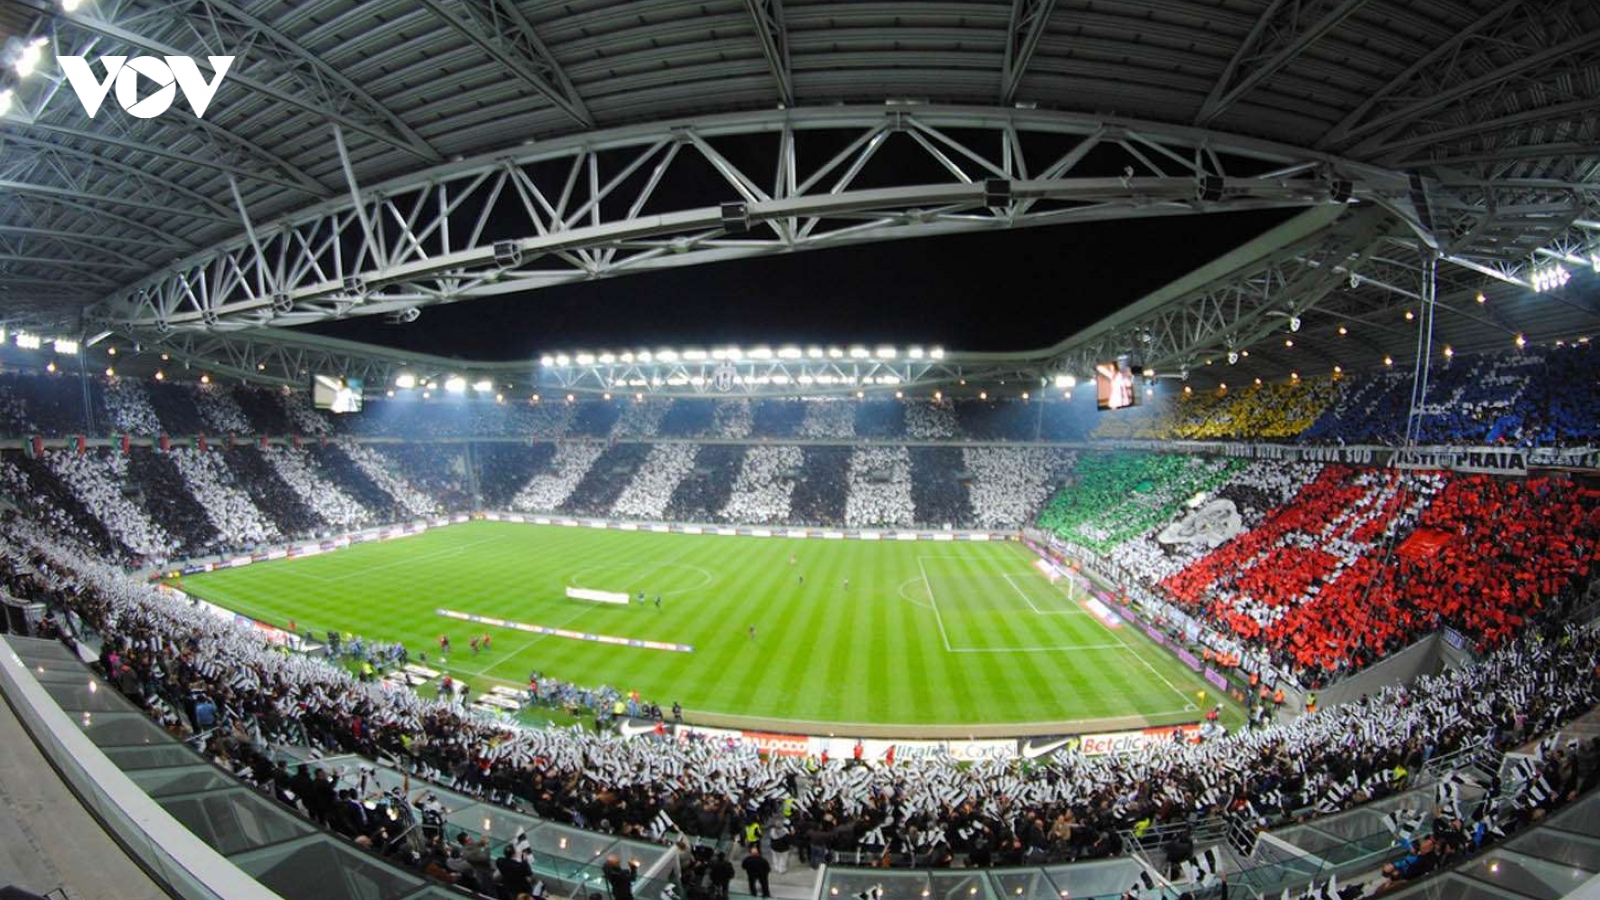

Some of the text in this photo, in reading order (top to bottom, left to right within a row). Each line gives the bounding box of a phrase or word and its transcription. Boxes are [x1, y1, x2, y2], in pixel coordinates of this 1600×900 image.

[1302, 447, 1340, 462] CURVA
[1345, 448, 1372, 464] SUD
[1455, 452, 1526, 470] PRAIA
[1083, 735, 1142, 753] Betclic
